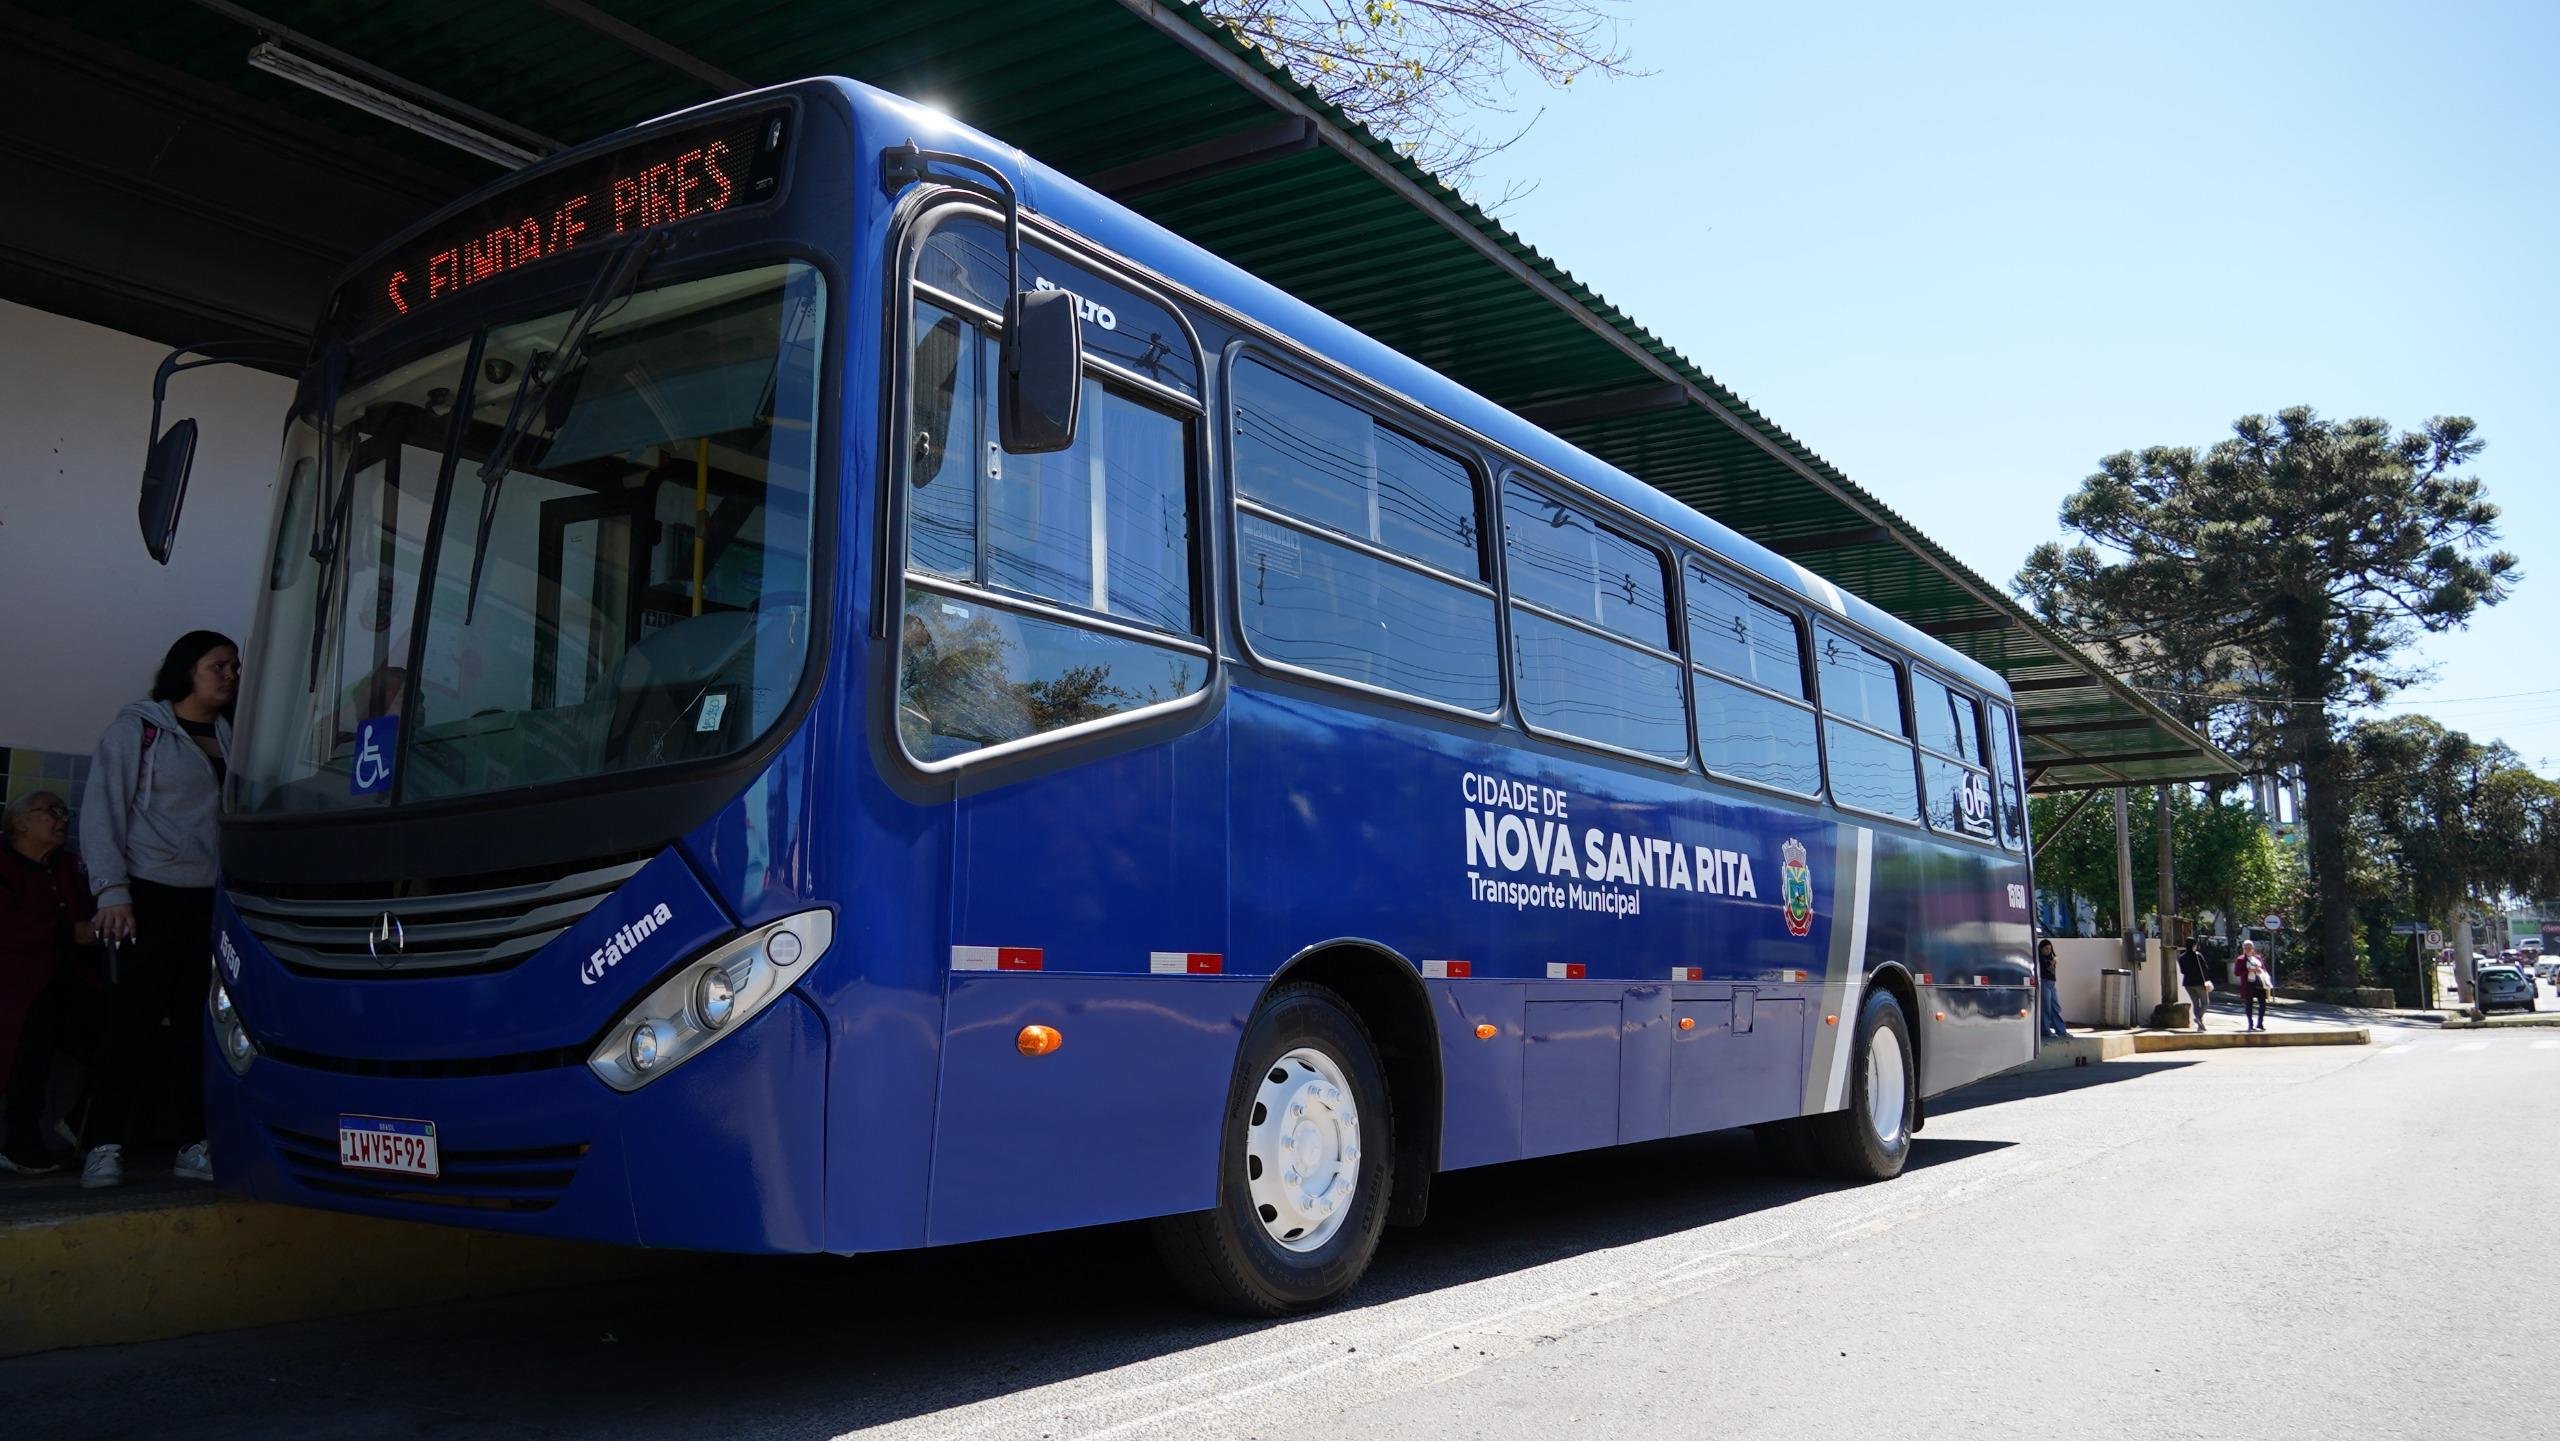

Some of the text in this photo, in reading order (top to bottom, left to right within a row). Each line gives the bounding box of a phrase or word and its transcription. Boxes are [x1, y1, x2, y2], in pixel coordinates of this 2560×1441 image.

[615, 140, 731, 234] PIRES
[1462, 771, 1568, 819] CIDADE DE
[1464, 807, 1758, 899] NOVA SANTA RITA
[1467, 870, 1640, 919] Transporte Municipal
[220, 930, 241, 980] 15150
[589, 902, 673, 978] Fátima
[349, 1132, 427, 1169] IWY5F92
[378, 1122, 396, 1132] BRASIL
